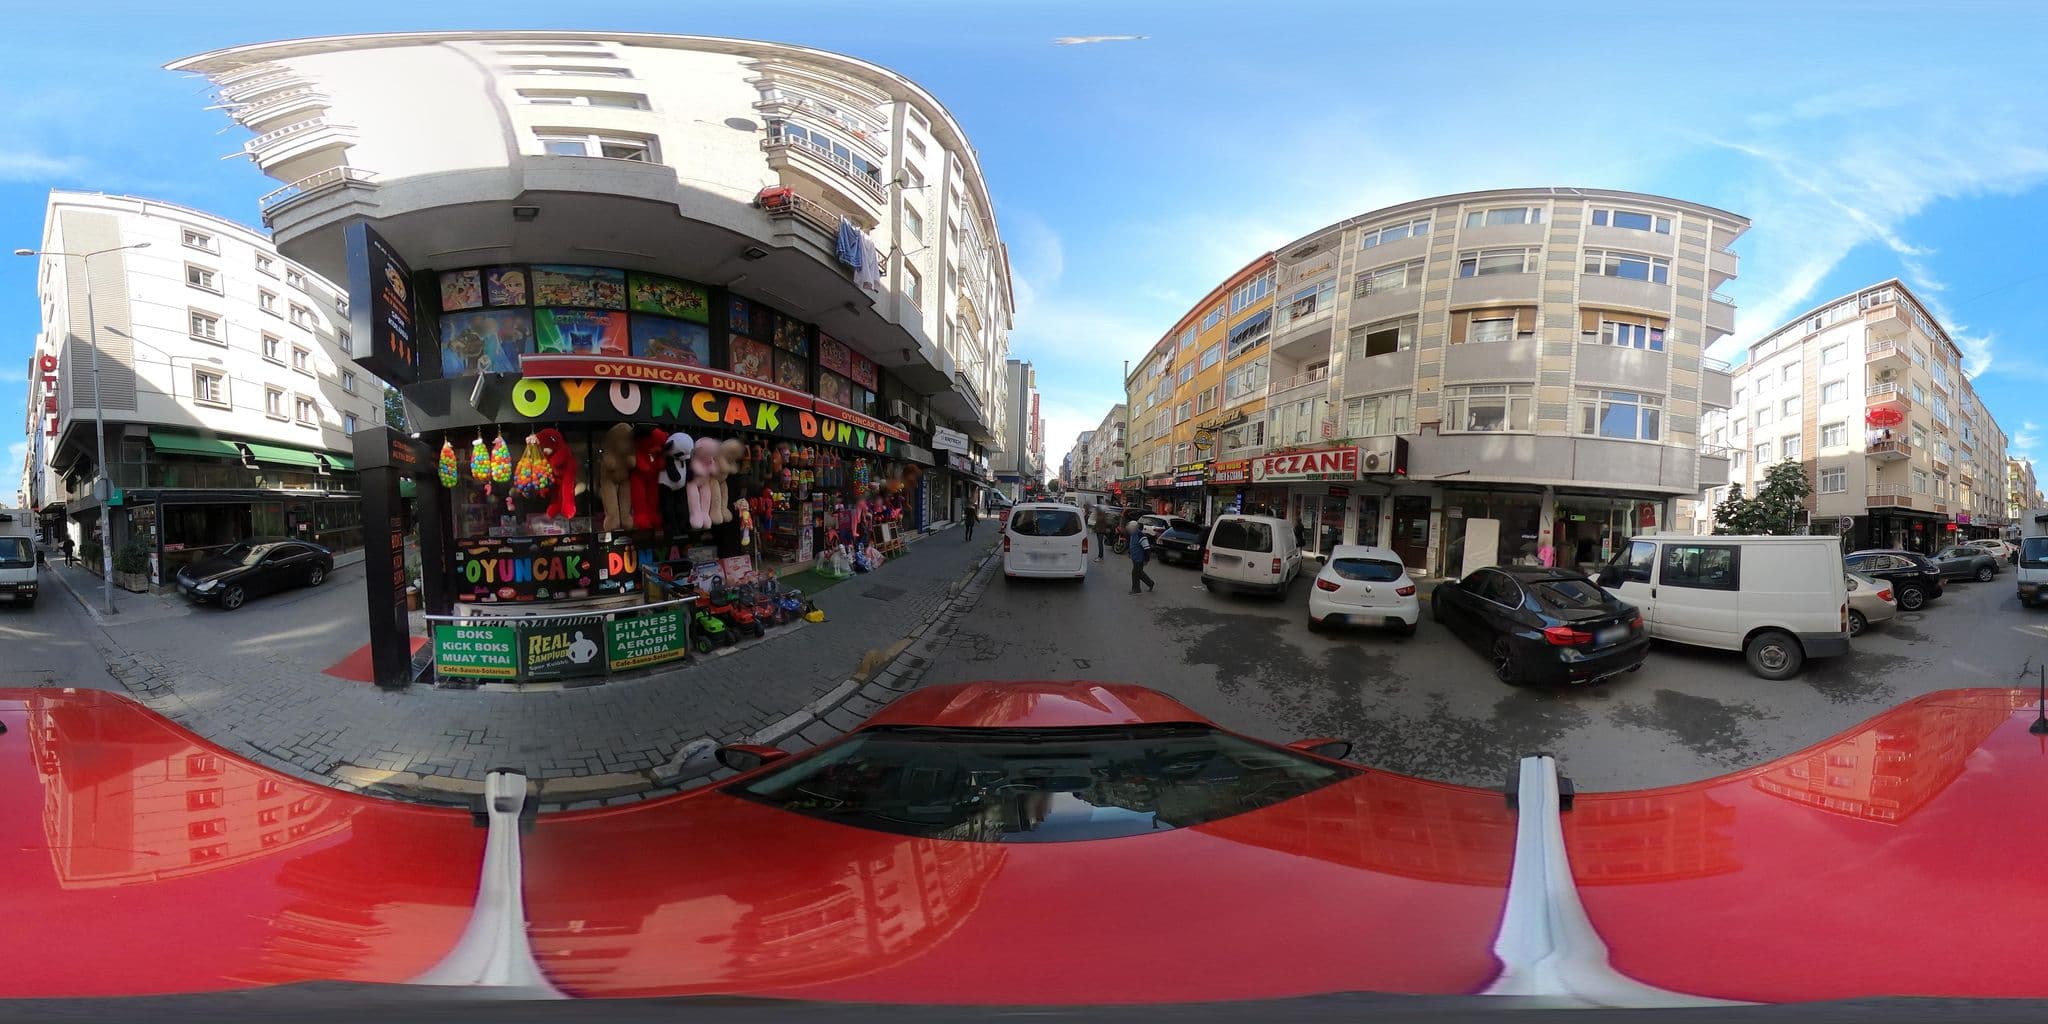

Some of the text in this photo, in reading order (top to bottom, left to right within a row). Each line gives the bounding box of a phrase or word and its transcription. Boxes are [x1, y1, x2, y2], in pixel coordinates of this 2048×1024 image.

[594, 363, 780, 400] OYUNCAK DÜNYASI
[512, 378, 781, 432] OYUNCAK
[842, 412, 876, 429] OYUNCAK
[1264, 452, 1355, 475] ECZANE
[466, 555, 581, 584] OYUNCAK
[456, 630, 493, 640] BOKS
[475, 643, 509, 652] BOKS
[626, 644, 669, 658] ZUMBA
[442, 654, 476, 662] MUAY
